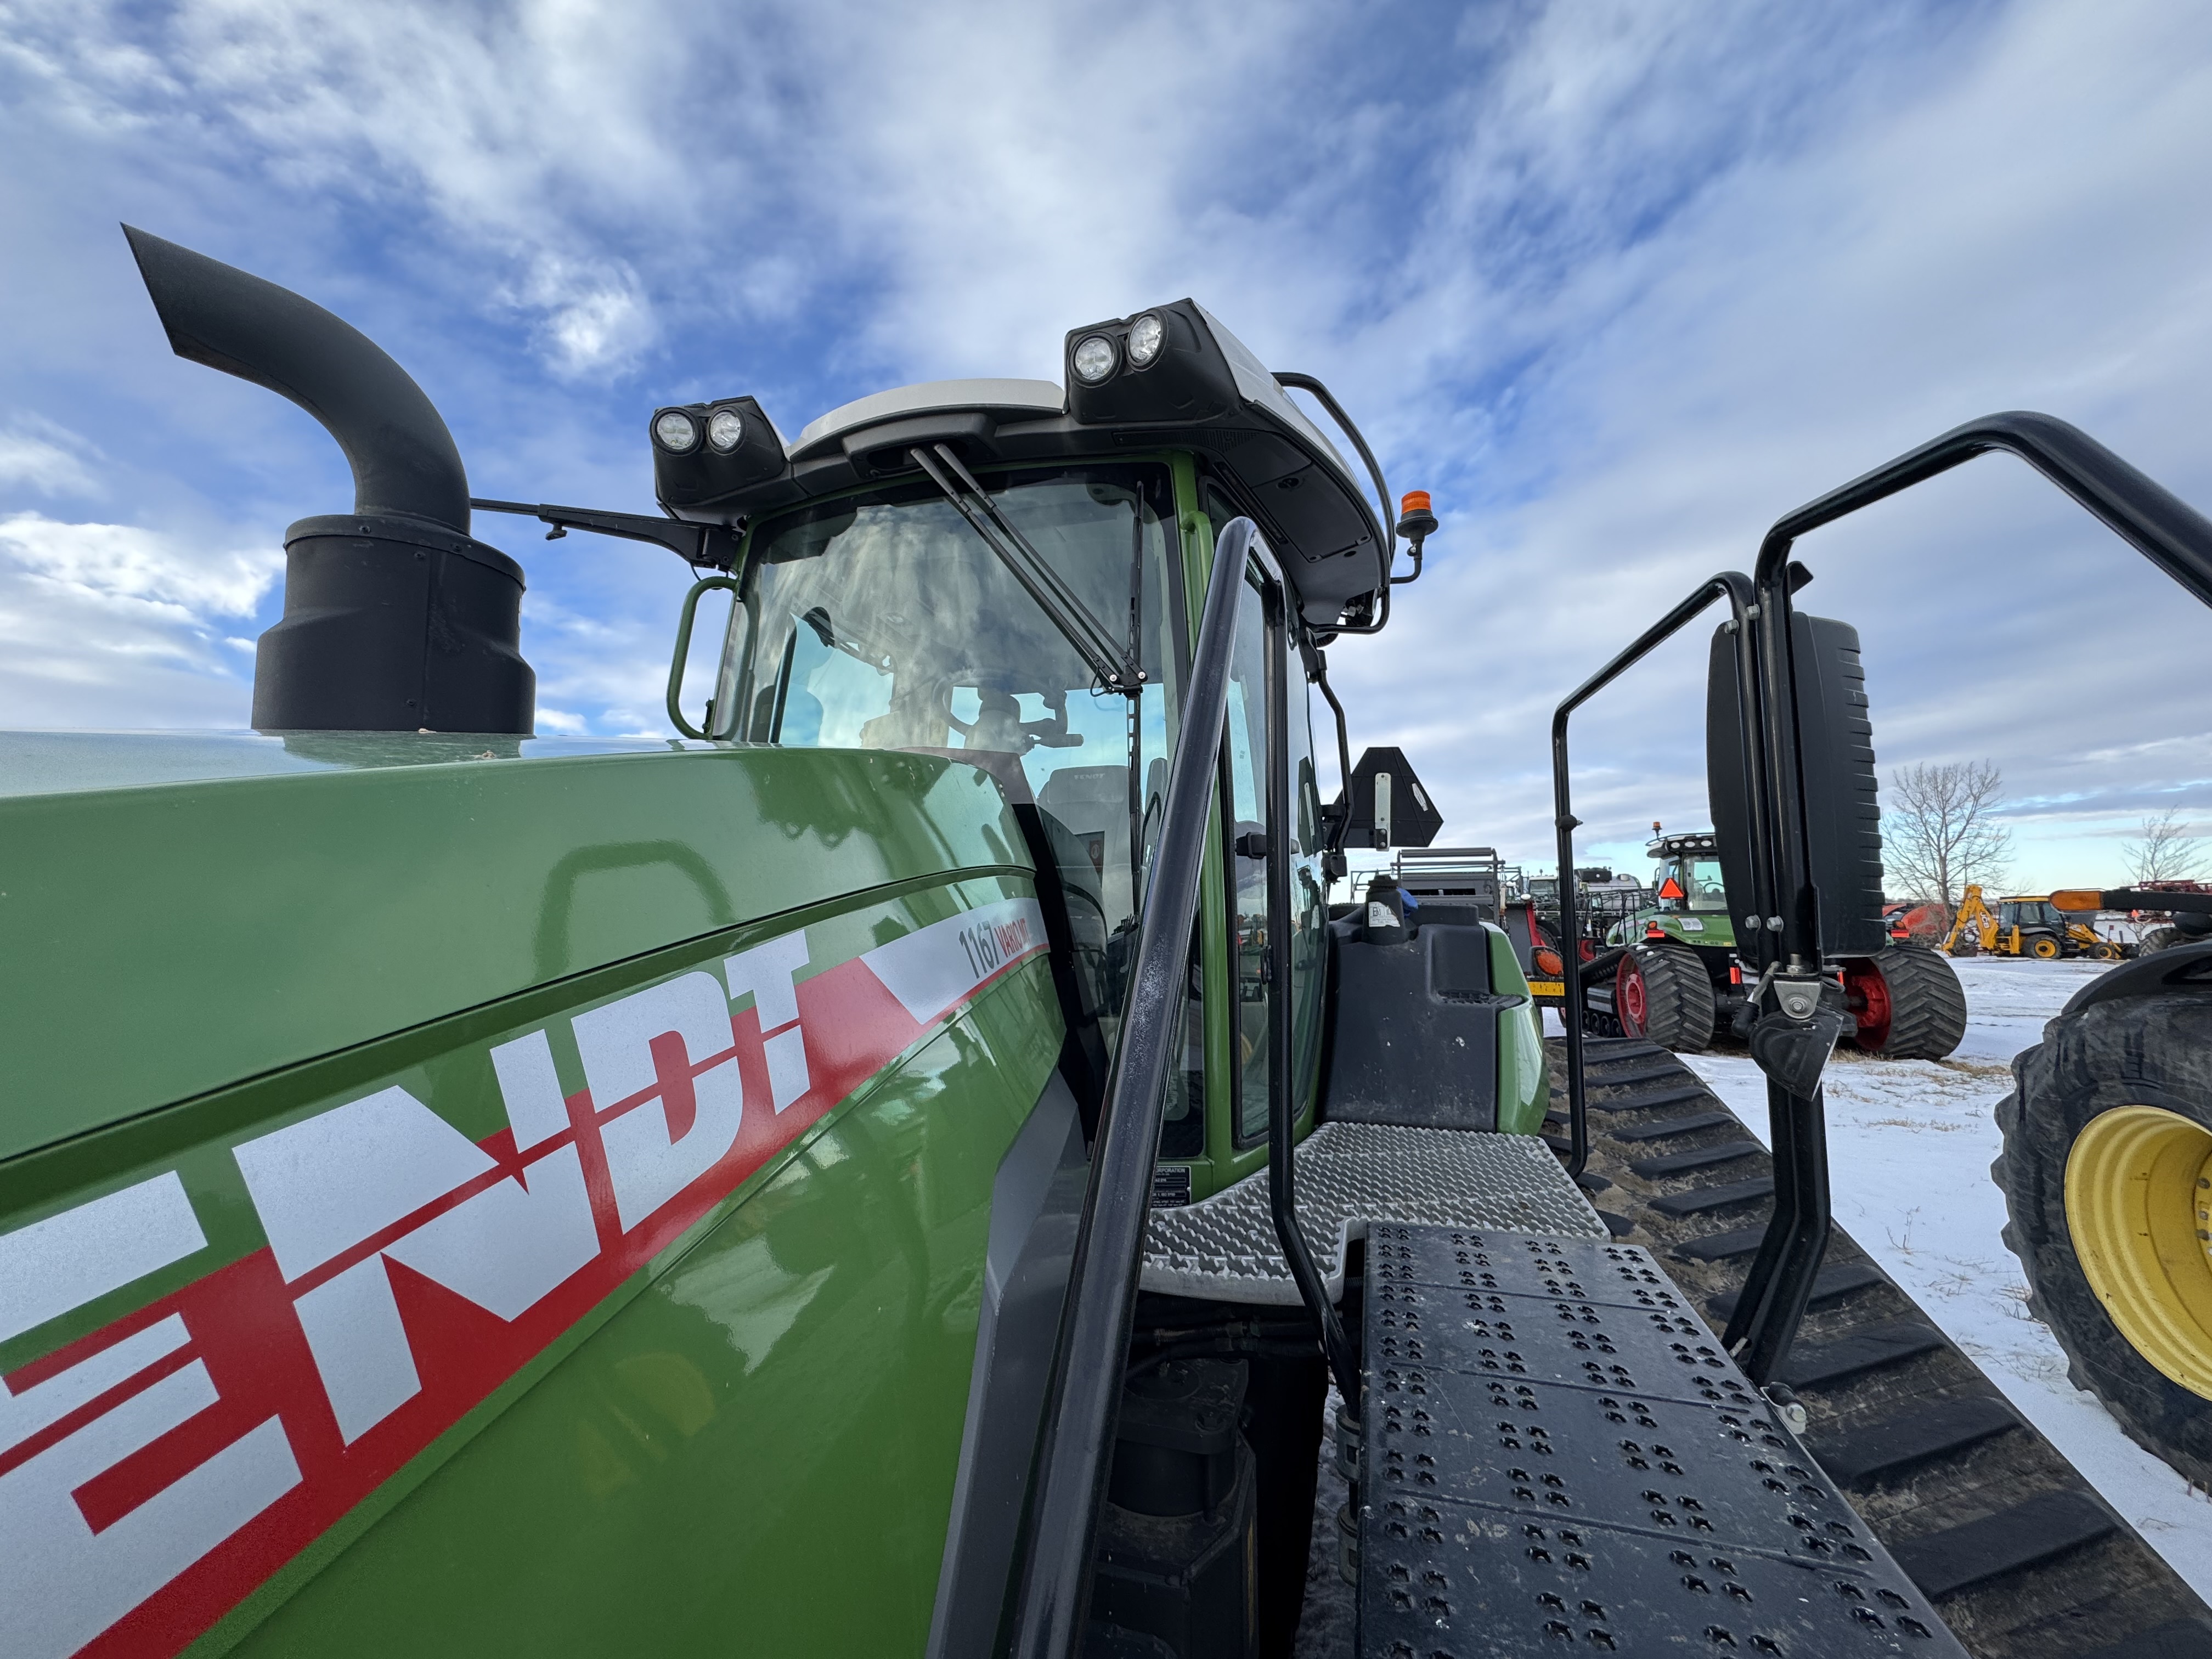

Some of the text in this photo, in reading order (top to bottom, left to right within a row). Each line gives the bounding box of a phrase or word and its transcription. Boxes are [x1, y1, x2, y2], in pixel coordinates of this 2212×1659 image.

[1979, 911, 1990, 928] JCB
[959, 920, 1000, 979] 1167
[994, 921, 1023, 958] VARIO
